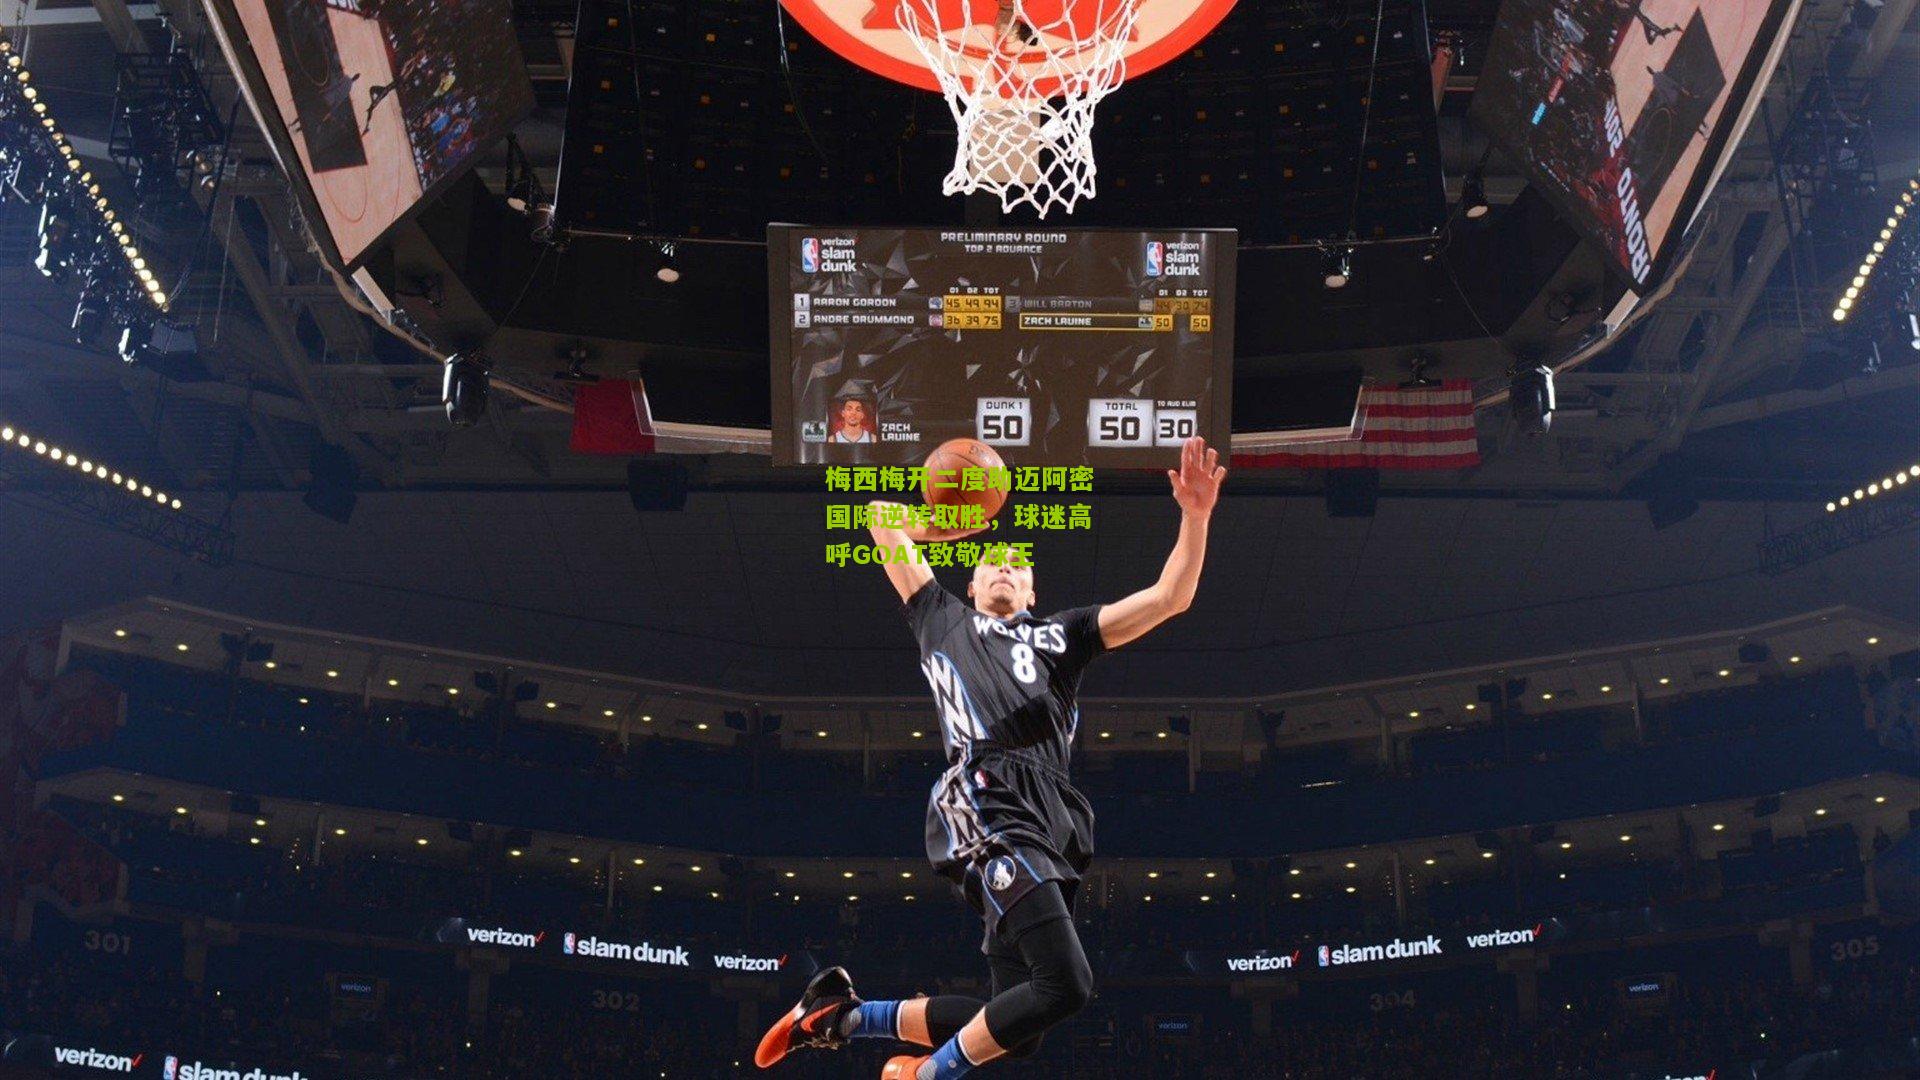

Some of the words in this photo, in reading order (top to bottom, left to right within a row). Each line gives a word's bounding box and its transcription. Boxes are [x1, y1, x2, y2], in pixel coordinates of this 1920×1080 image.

[821, 237, 855, 246] verizon
[941, 232, 1021, 242] PRELIMINARY
[1025, 233, 1067, 243] ROUND
[965, 245, 984, 253] TOP
[986, 245, 993, 253] 2
[996, 245, 1042, 254] ADVANCE
[1165, 241, 1199, 250] verizon
[821, 246, 855, 259] slam
[1165, 250, 1199, 263] slam
[821, 260, 857, 272] dunk
[1165, 264, 1200, 276] dunk
[813, 298, 850, 307] AARON
[853, 298, 897, 307] GORDON
[946, 299, 960, 308] 45
[965, 299, 980, 308] 49
[983, 299, 999, 308] 94
[799, 315, 806, 324] 2
[813, 315, 850, 324] ANDRE
[853, 315, 915, 324] DRUMMOND
[965, 315, 980, 325] 39
[983, 315, 999, 325] 75
[1024, 316, 1052, 325] ZACH
[1156, 318, 1169, 327] 50
[1193, 318, 1208, 327] 50
[986, 401, 1015, 410] DUNK
[1105, 402, 1138, 411] TOTAL
[881, 423, 911, 432] ZACH
[983, 415, 1023, 440] 50
[1100, 416, 1140, 441] 50
[1160, 418, 1193, 438] 30
[881, 433, 921, 442] LAVINE
[972, 616, 1067, 653] WOLVES
[1011, 643, 1037, 684] 8
[467, 927, 536, 948] verizon
[1466, 925, 1534, 949] verizon
[577, 936, 632, 960] slam
[633, 942, 690, 967] dunk
[1331, 944, 1384, 965] slam
[1386, 935, 1443, 960] dunk
[1830, 936, 1879, 962] 305
[714, 954, 779, 971] verizon
[1227, 950, 1292, 972] verizon
[340, 982, 372, 994] verizon
[1628, 982, 1660, 993] verizon
[55, 1047, 132, 1072] verizon
